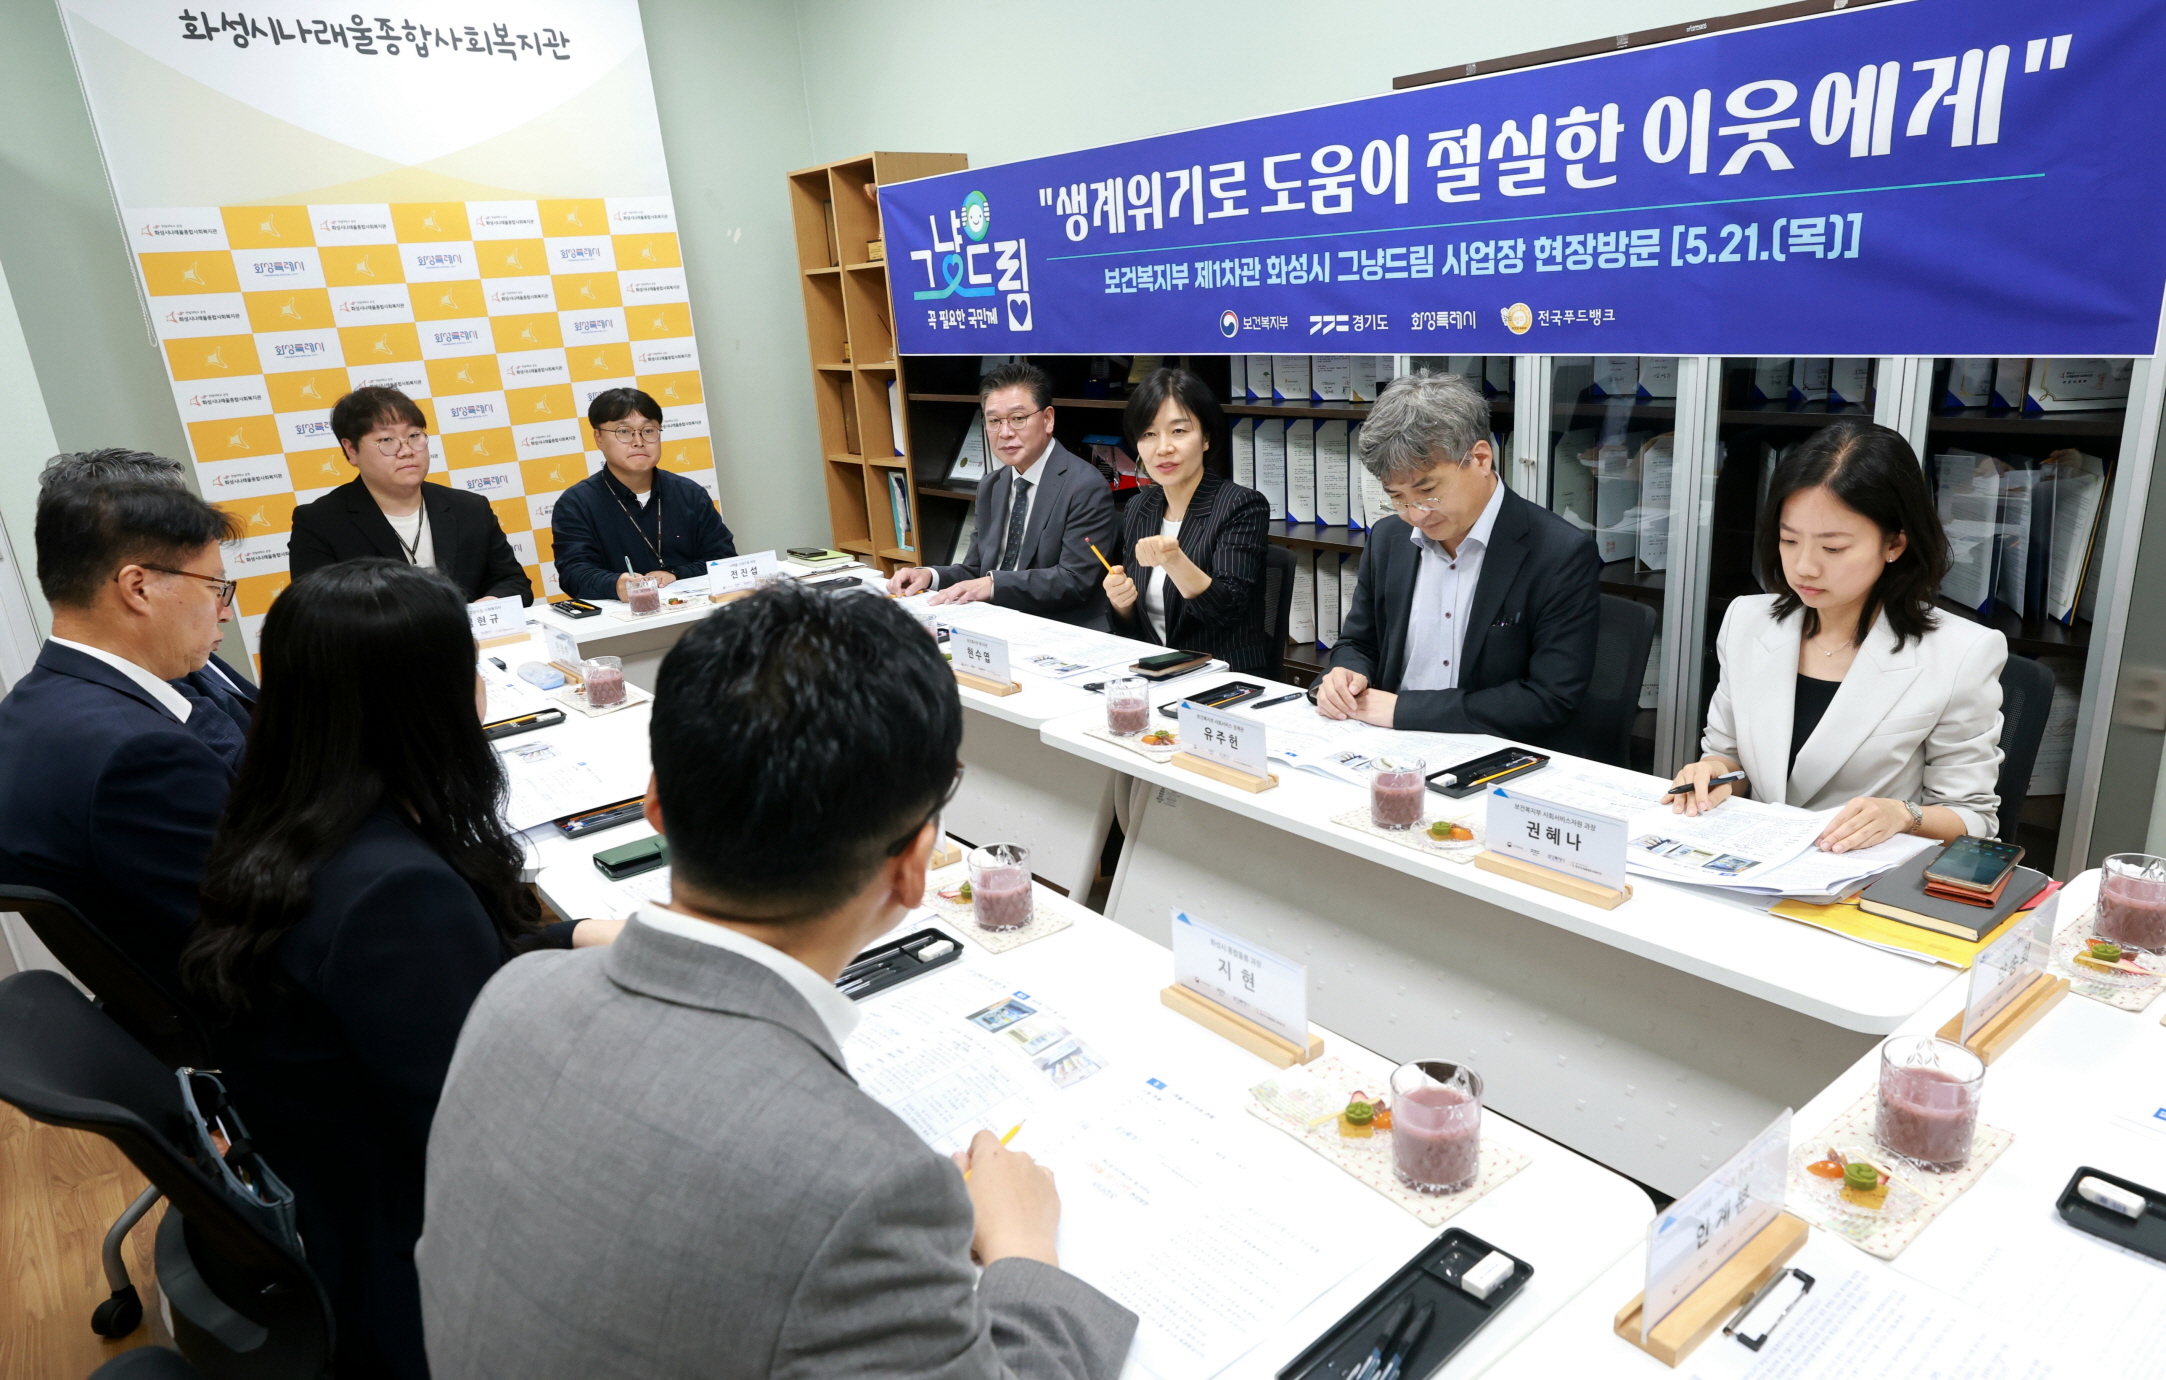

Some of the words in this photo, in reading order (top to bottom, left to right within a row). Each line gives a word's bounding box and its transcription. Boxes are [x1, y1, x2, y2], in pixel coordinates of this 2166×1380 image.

[178, 9, 570, 61] 화성시나래울종합사회복지관
[1039, 161, 1249, 241] "생계위기로
[1261, 134, 1409, 214] 도움이
[1427, 103, 1624, 202] 절실한
[1641, 33, 2073, 176] 이웃에게"
[1104, 258, 1191, 294] 보건복지부
[1195, 257, 1261, 288] 제1차관
[1267, 252, 1330, 284] 화성시
[1338, 245, 1433, 281] 그냥드림
[1442, 238, 1526, 276] 사업장
[1534, 229, 1660, 272] 현장방문
[1671, 213, 1863, 266] [5.21.(목)]
[928, 311, 936, 329] 꼭
[939, 309, 965, 329] 필요한
[968, 307, 998, 328] 국민께
[1243, 316, 1288, 330] 보건복지부
[1353, 315, 1388, 331] 경기도
[1411, 311, 1476, 330] 화성특례시
[1538, 309, 1615, 326] 전국푸드뱅크
[730, 566, 758, 580] 전진섭
[1204, 727, 1238, 750] 유주헌
[1514, 804, 1541, 816] 보건복지부
[1543, 812, 1582, 828] 사회서비스자원
[1584, 822, 1596, 831] 과장
[1526, 820, 1582, 851] 권혜나
